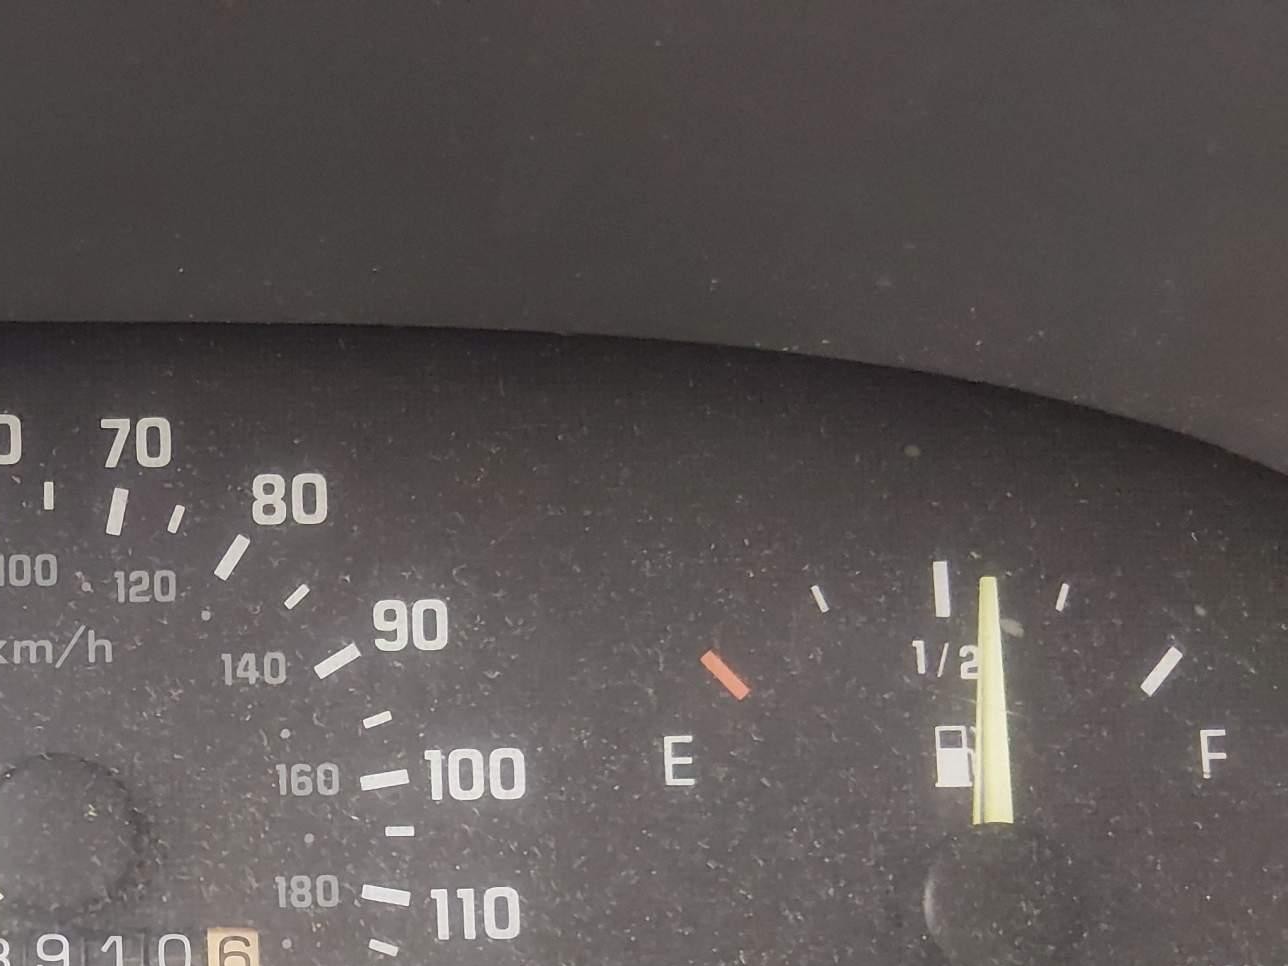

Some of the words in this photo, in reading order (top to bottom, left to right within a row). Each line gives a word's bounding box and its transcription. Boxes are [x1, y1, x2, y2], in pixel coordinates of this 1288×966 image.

[100, 417, 171, 467] 70
[252, 473, 328, 525] 80
[114, 570, 176, 603] 120
[373, 599, 448, 651] 90
[221, 651, 287, 685] 140
[912, 640, 979, 679] 1/2
[275, 762, 340, 796] 160
[424, 748, 526, 801] 100
[663, 735, 695, 786] E
[1200, 729, 1227, 779] F
[274, 875, 340, 908] 180
[430, 886, 520, 940] 110
